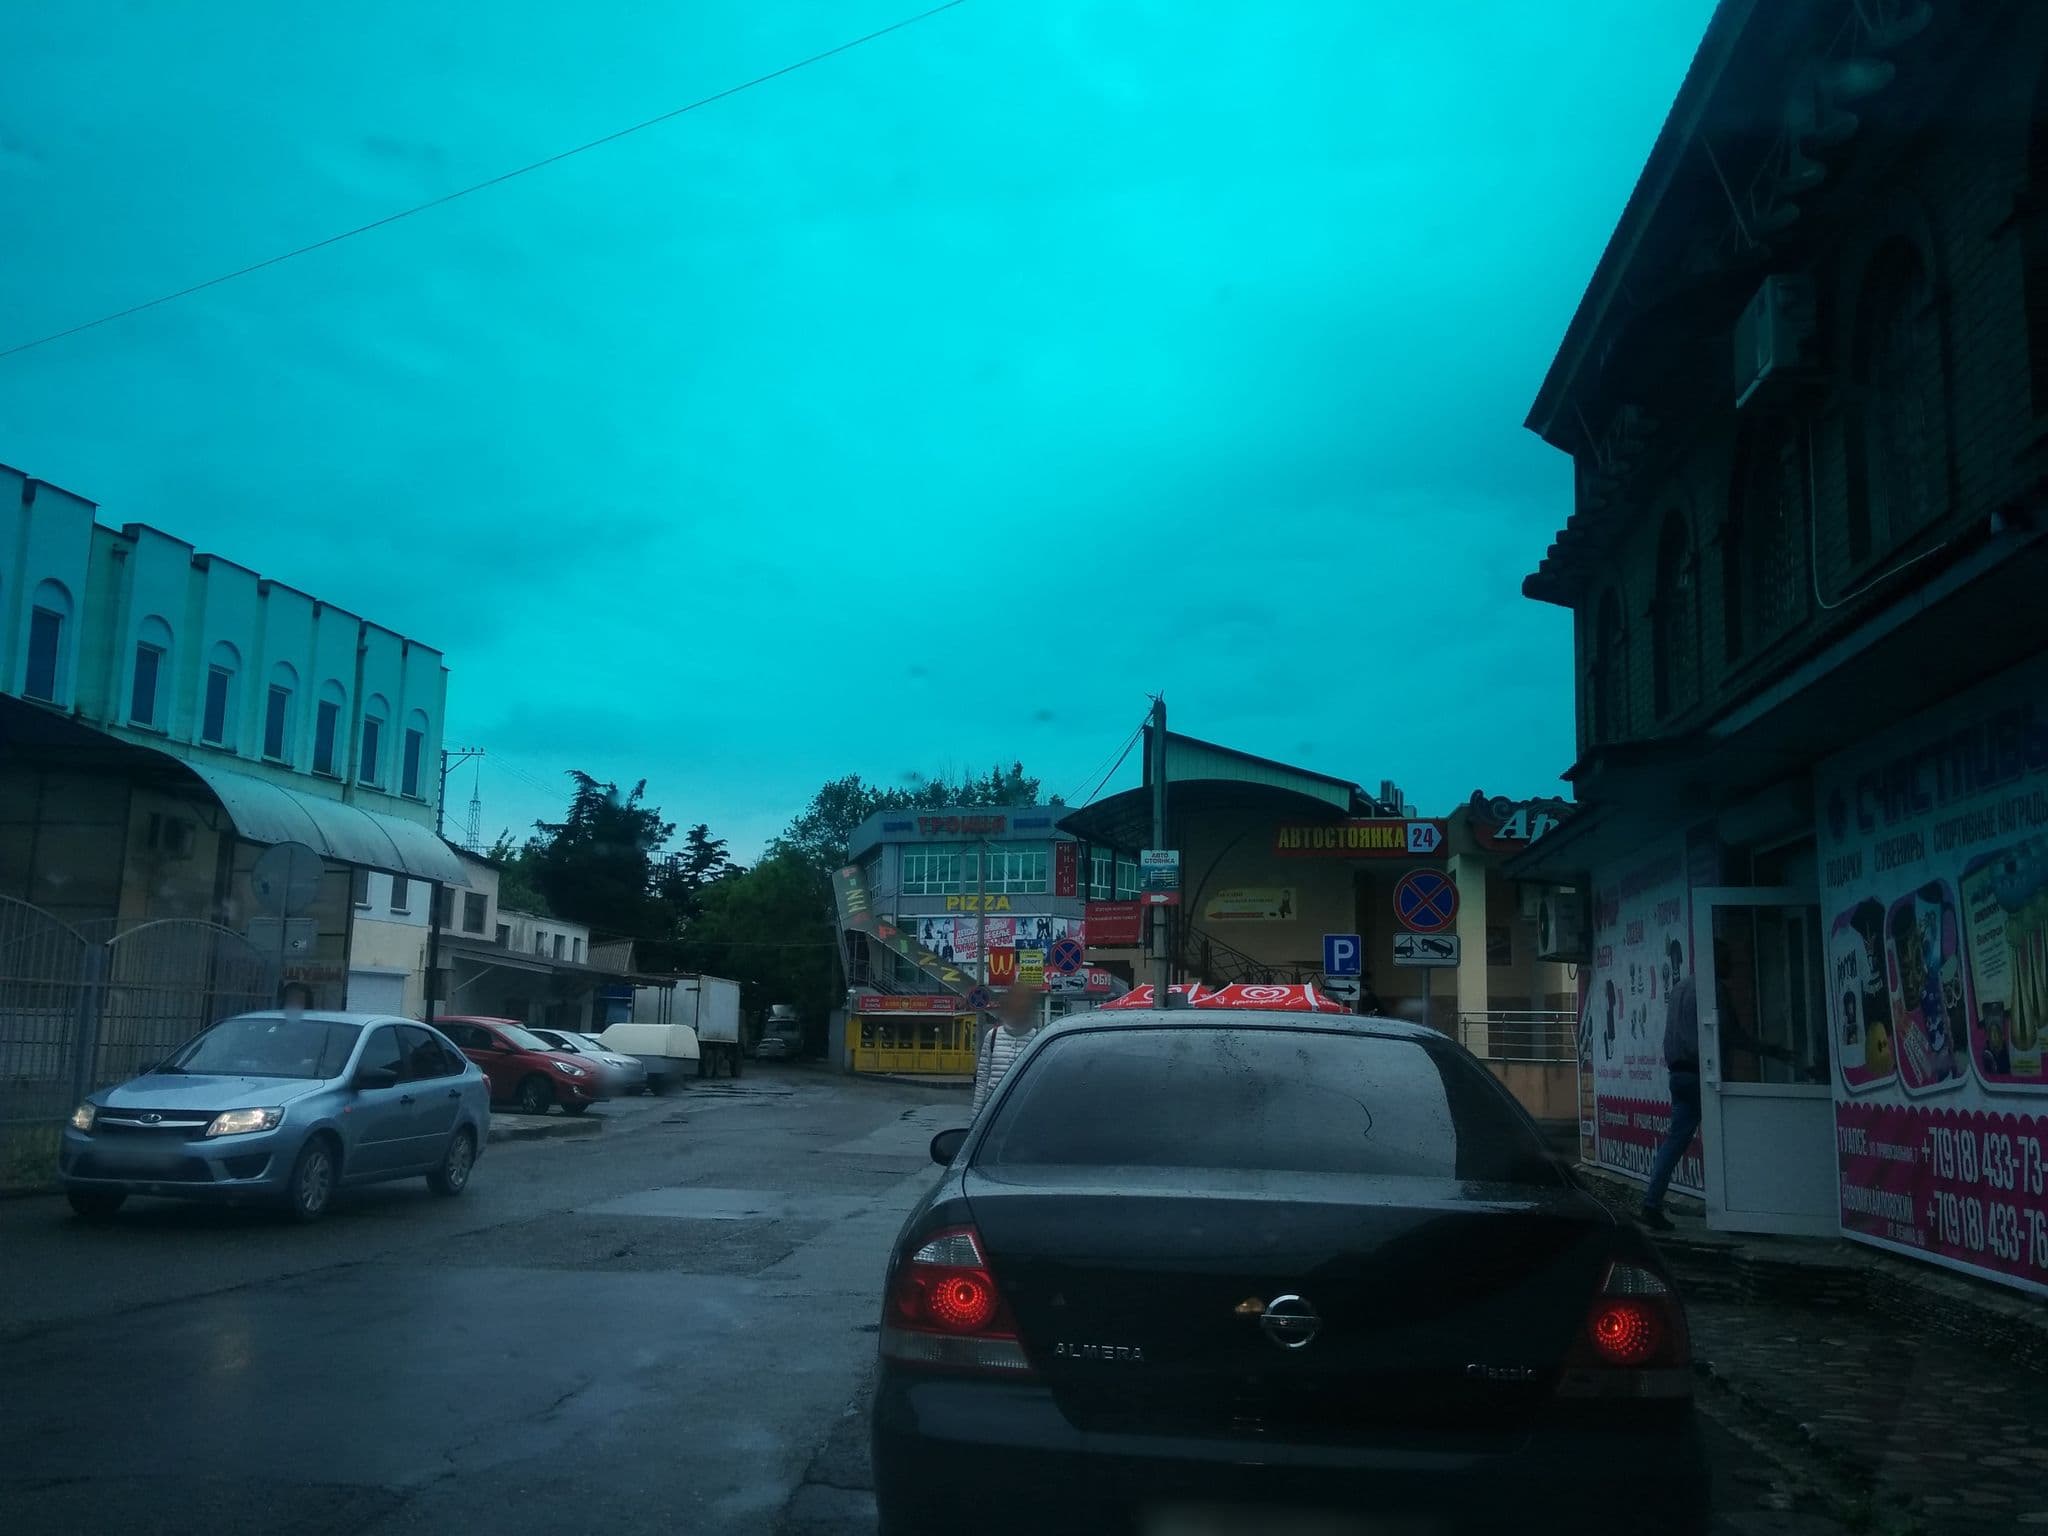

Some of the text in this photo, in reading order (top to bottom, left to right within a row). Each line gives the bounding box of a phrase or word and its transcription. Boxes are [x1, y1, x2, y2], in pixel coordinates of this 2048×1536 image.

[1278, 826, 1434, 849] АВТОСТОЯНКА 24
[1873, 831, 1925, 873] СУВЕНИРЫ
[946, 896, 1012, 911] PIZZA
[1333, 939, 1355, 971] P
[1838, 1127, 1867, 1156] ТУАПСЕ
[1921, 1126, 1979, 1183] +7(918)
[1600, 1136, 1703, 1187] www.smpodk.ru
[1926, 1190, 1985, 1252] +7(918)
[1055, 1342, 1144, 1361] ALMERA
